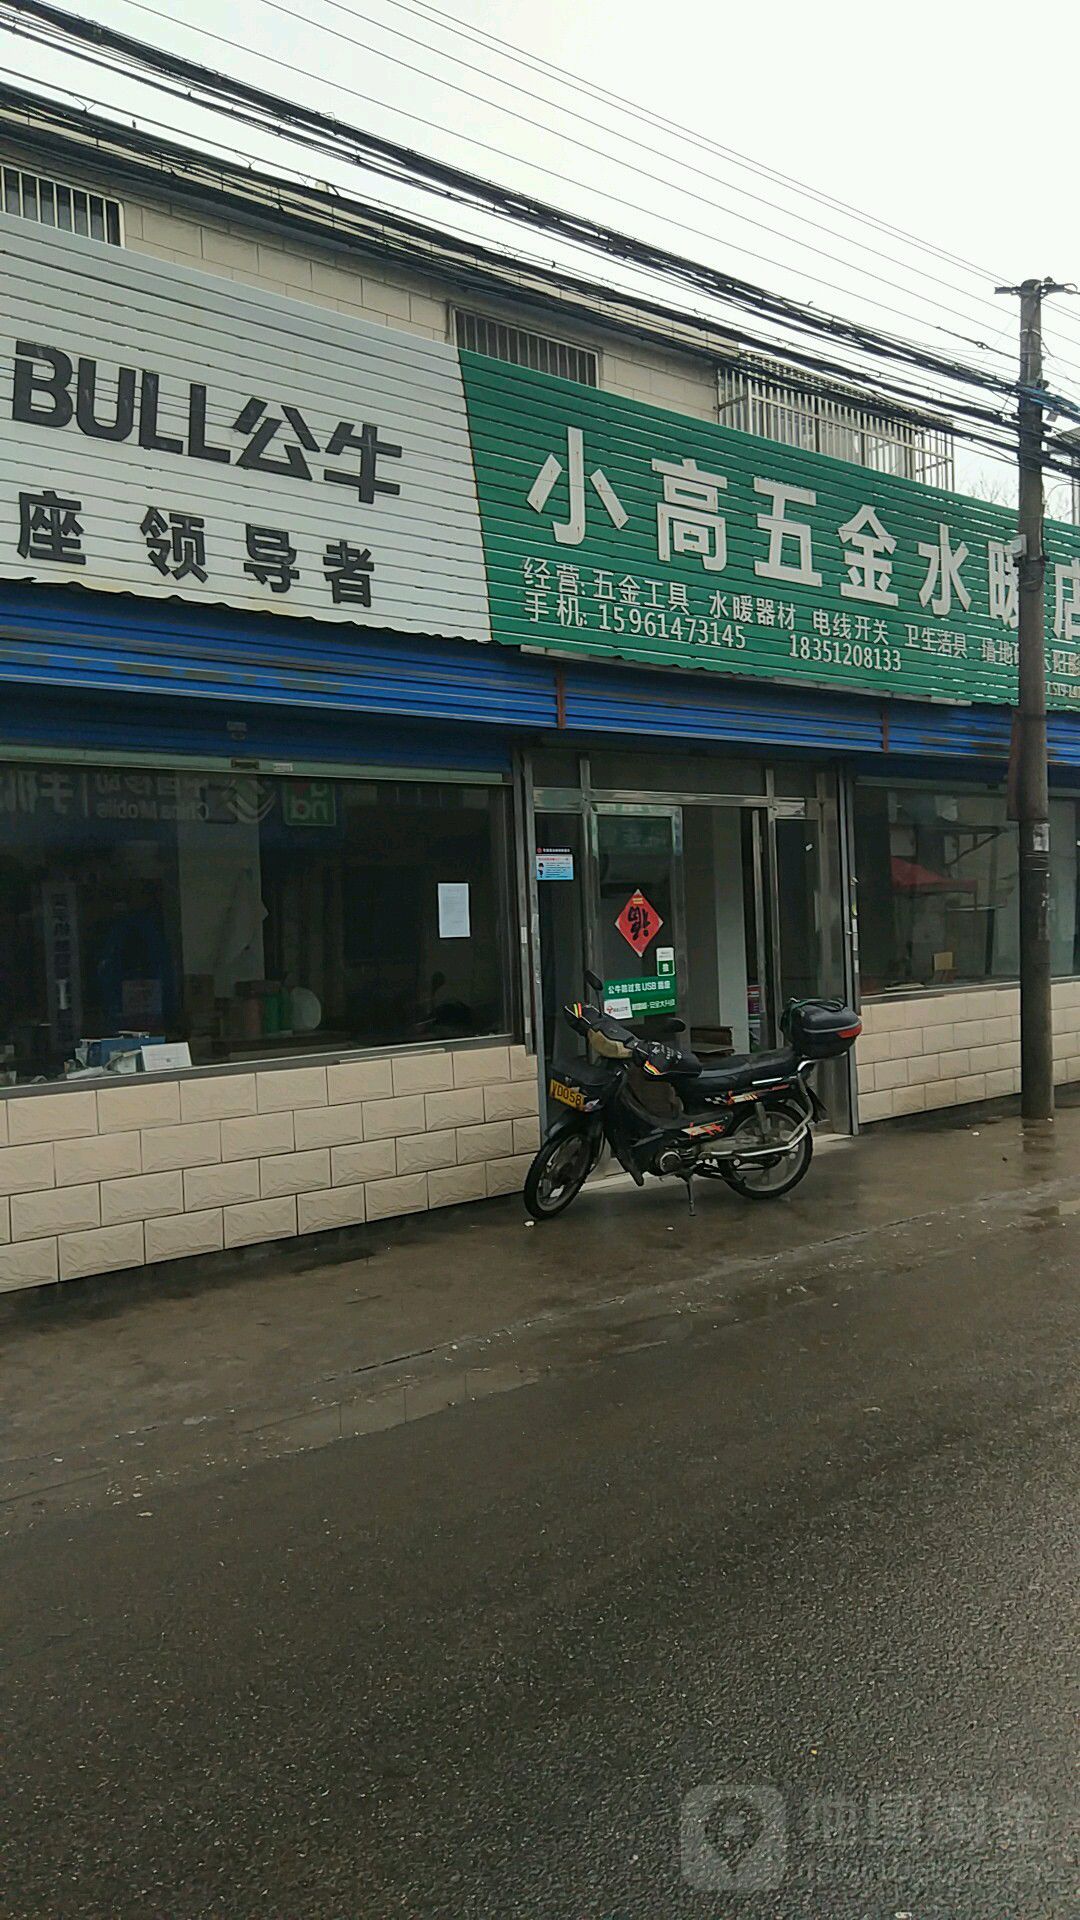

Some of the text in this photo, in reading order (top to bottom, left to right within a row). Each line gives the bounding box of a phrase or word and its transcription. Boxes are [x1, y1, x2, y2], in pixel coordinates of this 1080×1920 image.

[17, 490, 375, 607] 座领导者
[708, 590, 796, 630] 水暖器材
[812, 608, 889, 645] 电线开关
[904, 624, 968, 659] 卫生洁具
[789, 634, 901, 671] 18351208133
